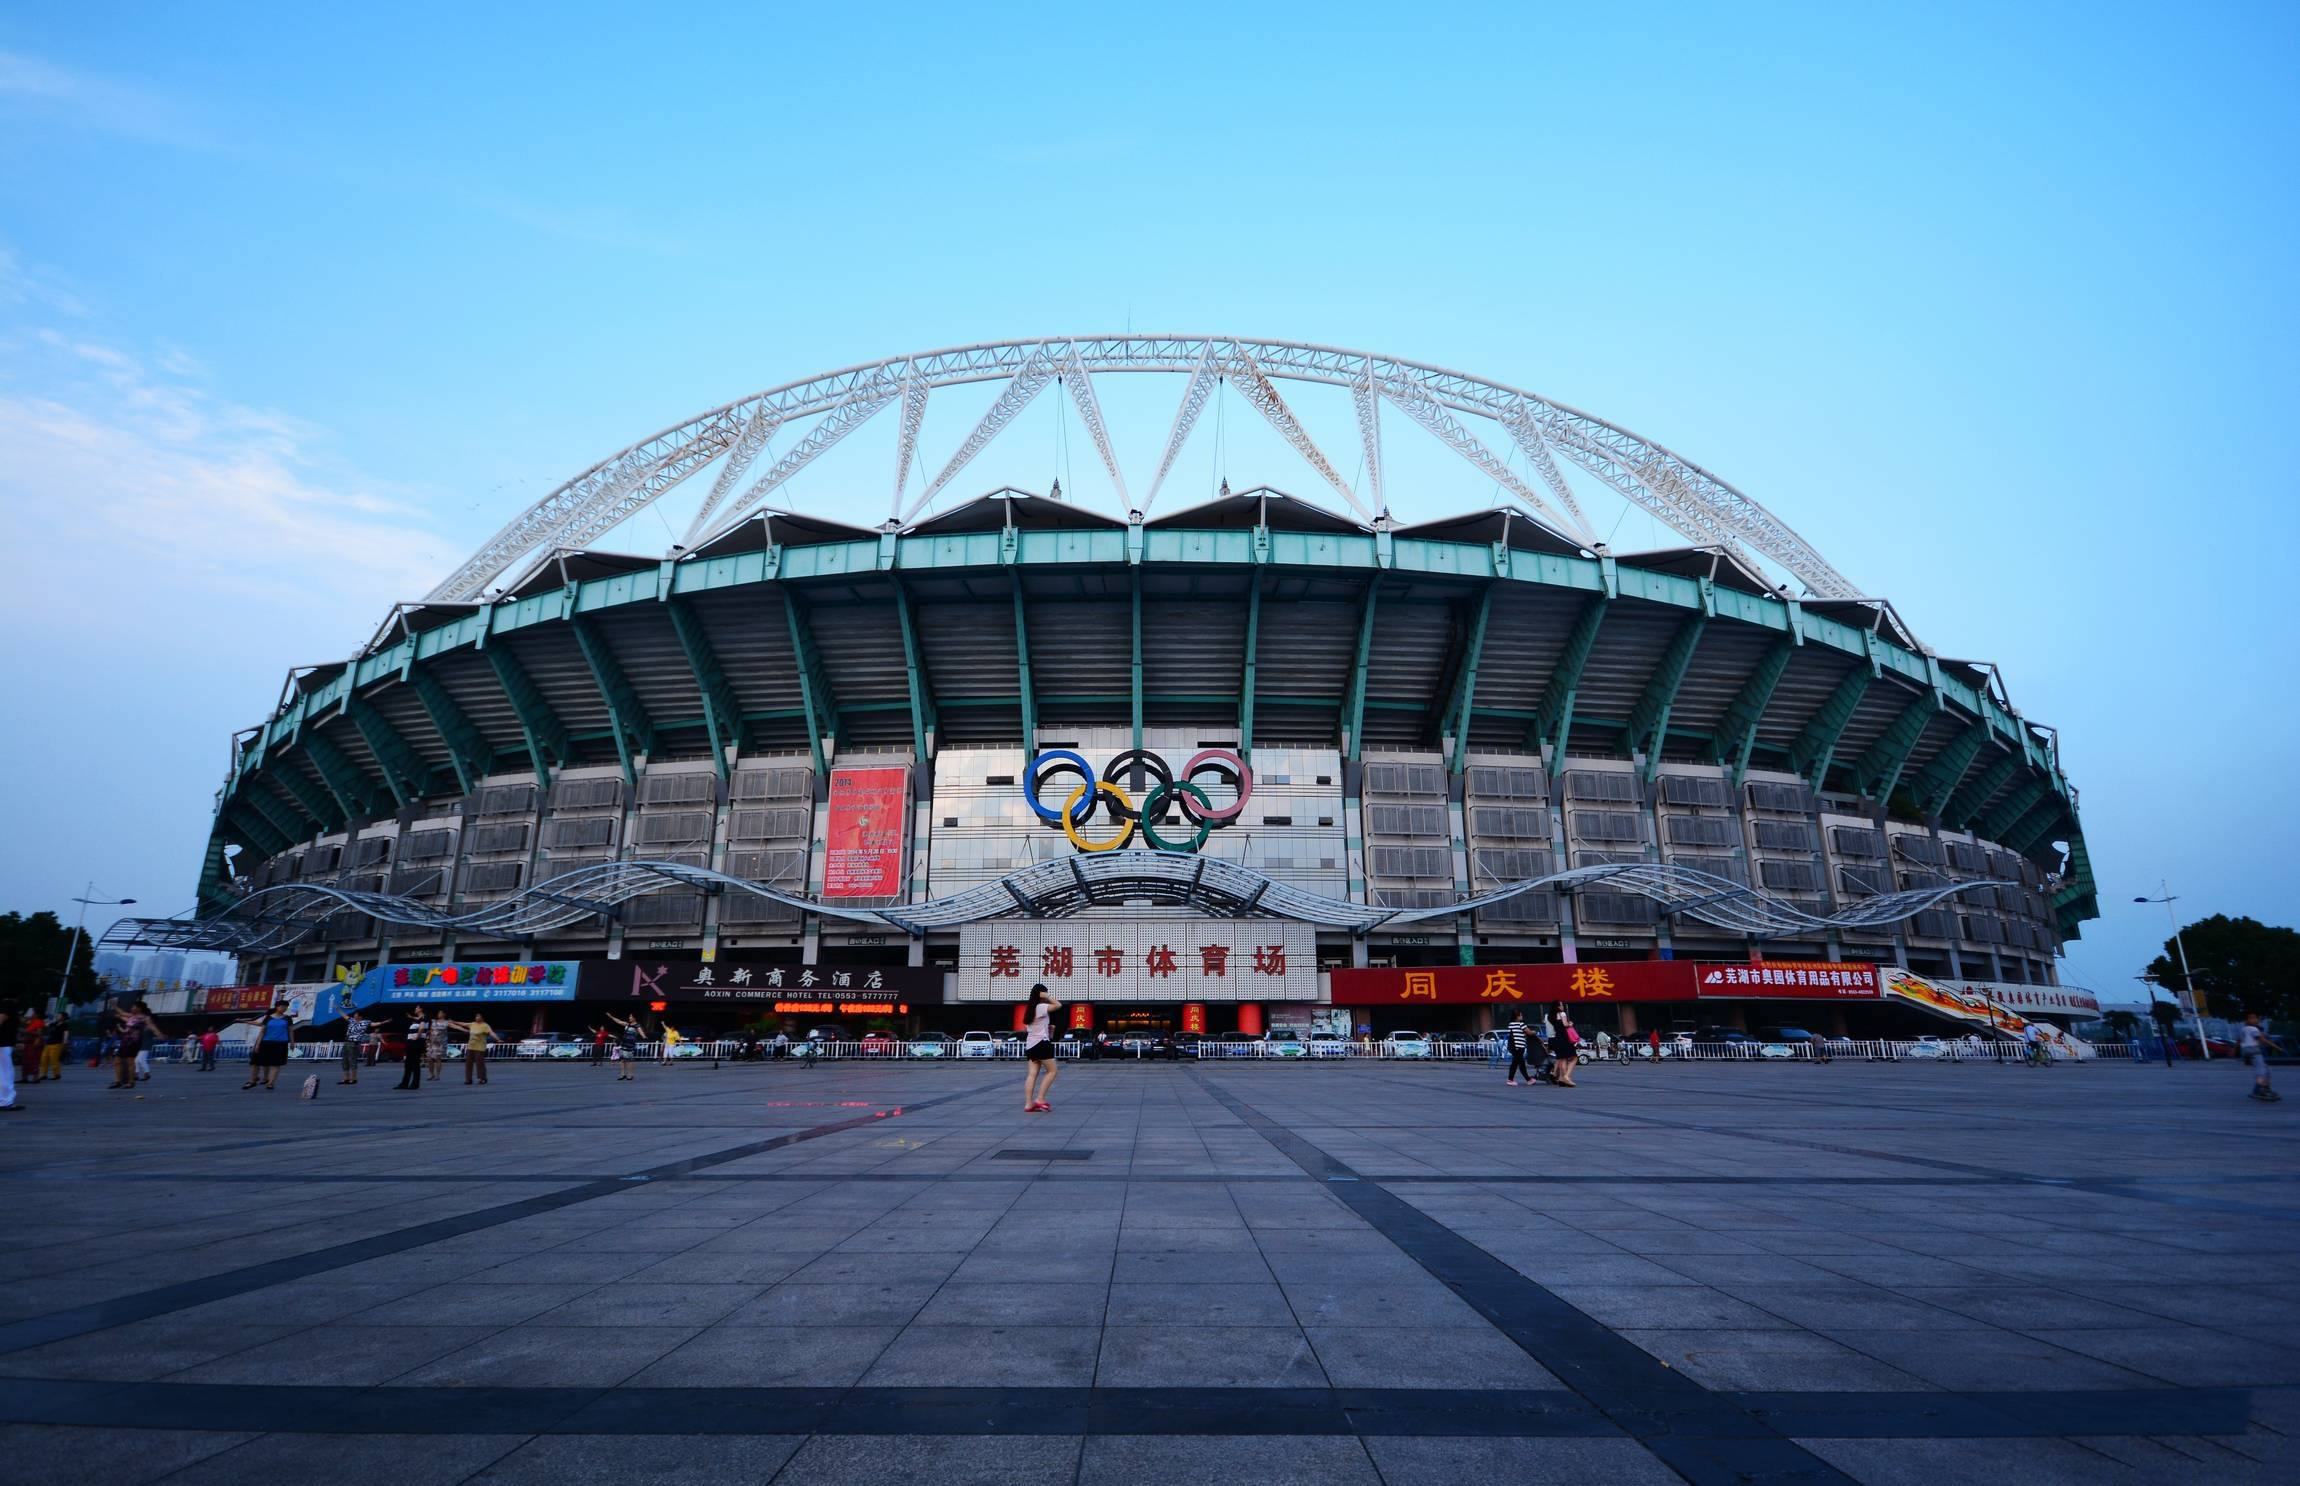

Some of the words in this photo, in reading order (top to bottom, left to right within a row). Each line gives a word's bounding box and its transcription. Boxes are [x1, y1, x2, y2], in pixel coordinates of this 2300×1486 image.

[990, 944, 1287, 978] 芜湖市体育场
[692, 966, 886, 990] 奥新商务酒店
[1400, 967, 1615, 999] 同庆楼
[1725, 967, 1874, 987] 芜湖市奥园体育用品有限公司
[704, 990, 731, 998] AOXIN
[735, 991, 783, 999] COMMERCE
[1190, 1006, 1200, 1031] 同庆楼
